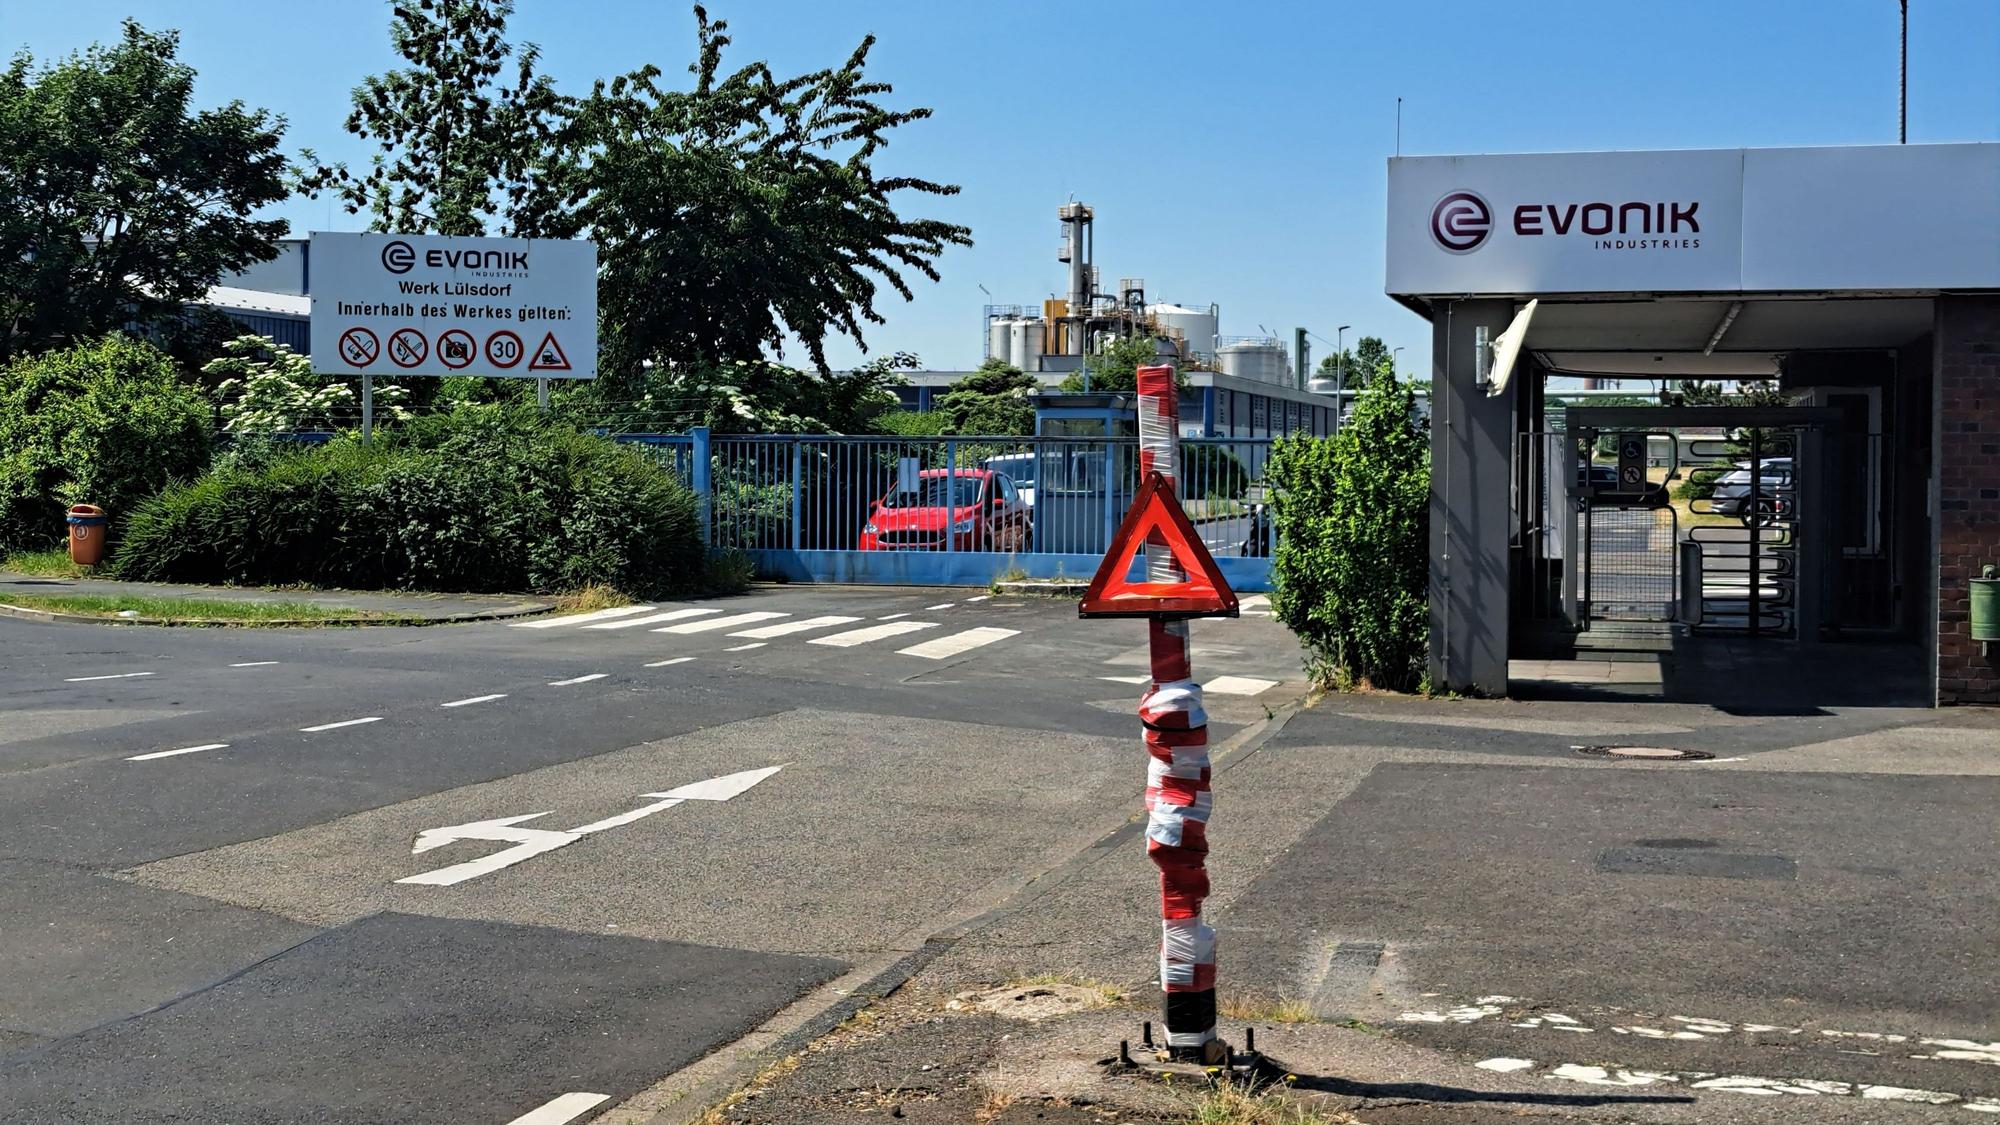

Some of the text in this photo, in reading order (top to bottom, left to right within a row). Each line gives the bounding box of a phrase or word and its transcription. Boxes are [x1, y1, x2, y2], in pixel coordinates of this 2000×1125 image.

[1514, 202, 1700, 235] EVONIK
[1595, 239, 1700, 249] INDUSTRIES
[426, 249, 528, 270] EVONIK
[399, 281, 511, 297] Werk Lülsdorf
[338, 302, 571, 321] Innerhalb des Werkes gelten:
[493, 341, 516, 359] 30
